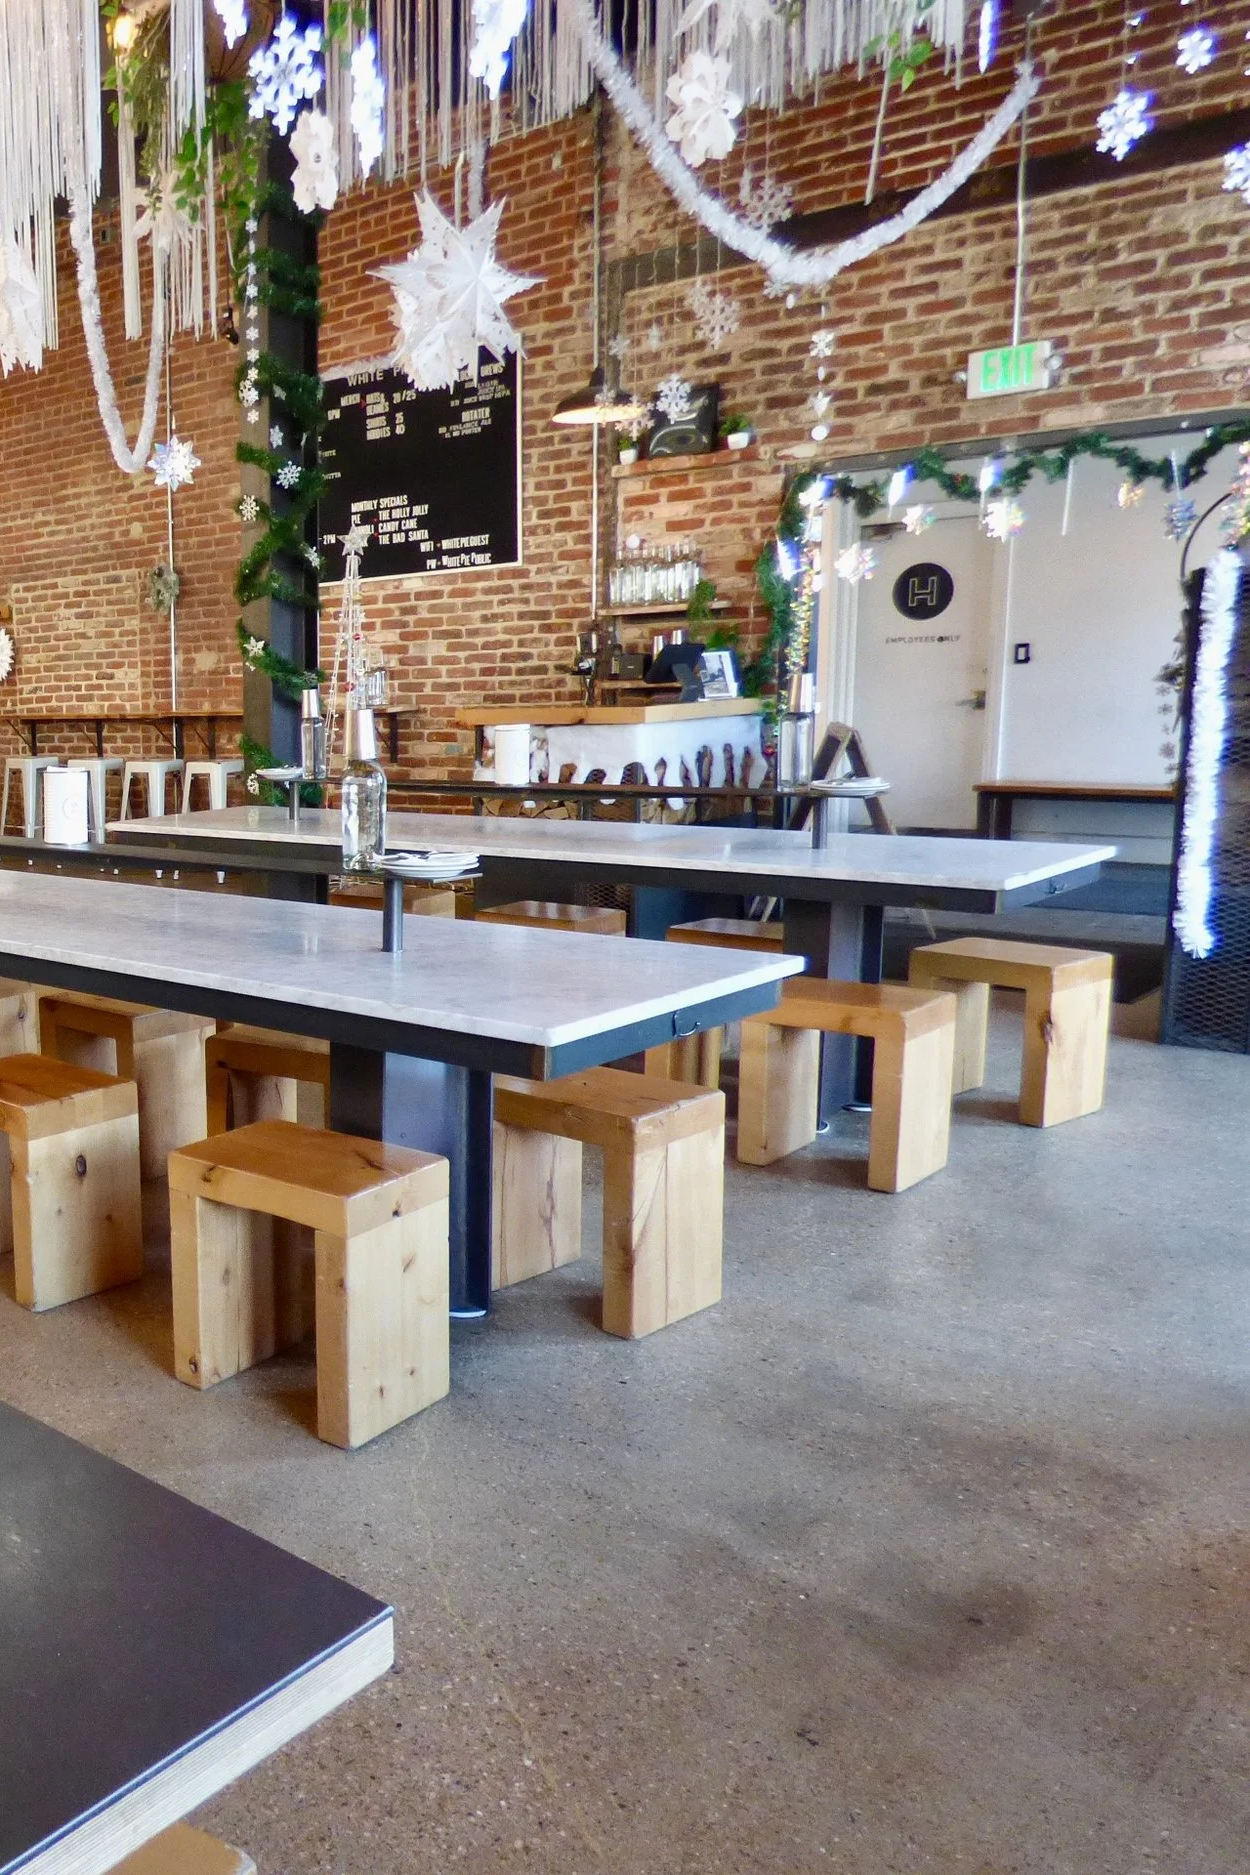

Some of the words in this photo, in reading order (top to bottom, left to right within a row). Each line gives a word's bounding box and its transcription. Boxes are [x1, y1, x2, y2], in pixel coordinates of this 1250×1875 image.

[980, 344, 1038, 392] EXIT
[348, 368, 384, 387] WHITE
[351, 499, 378, 513] MONTHLY
[379, 495, 408, 509] SPECIALS
[378, 509, 390, 521] THE
[378, 521, 399, 533] CANDY
[401, 518, 418, 530] CANE
[378, 534, 390, 545] THE
[408, 529, 429, 541] SANTA
[908, 576, 938, 607] H
[885, 636, 935, 644] EMPLOYEES
